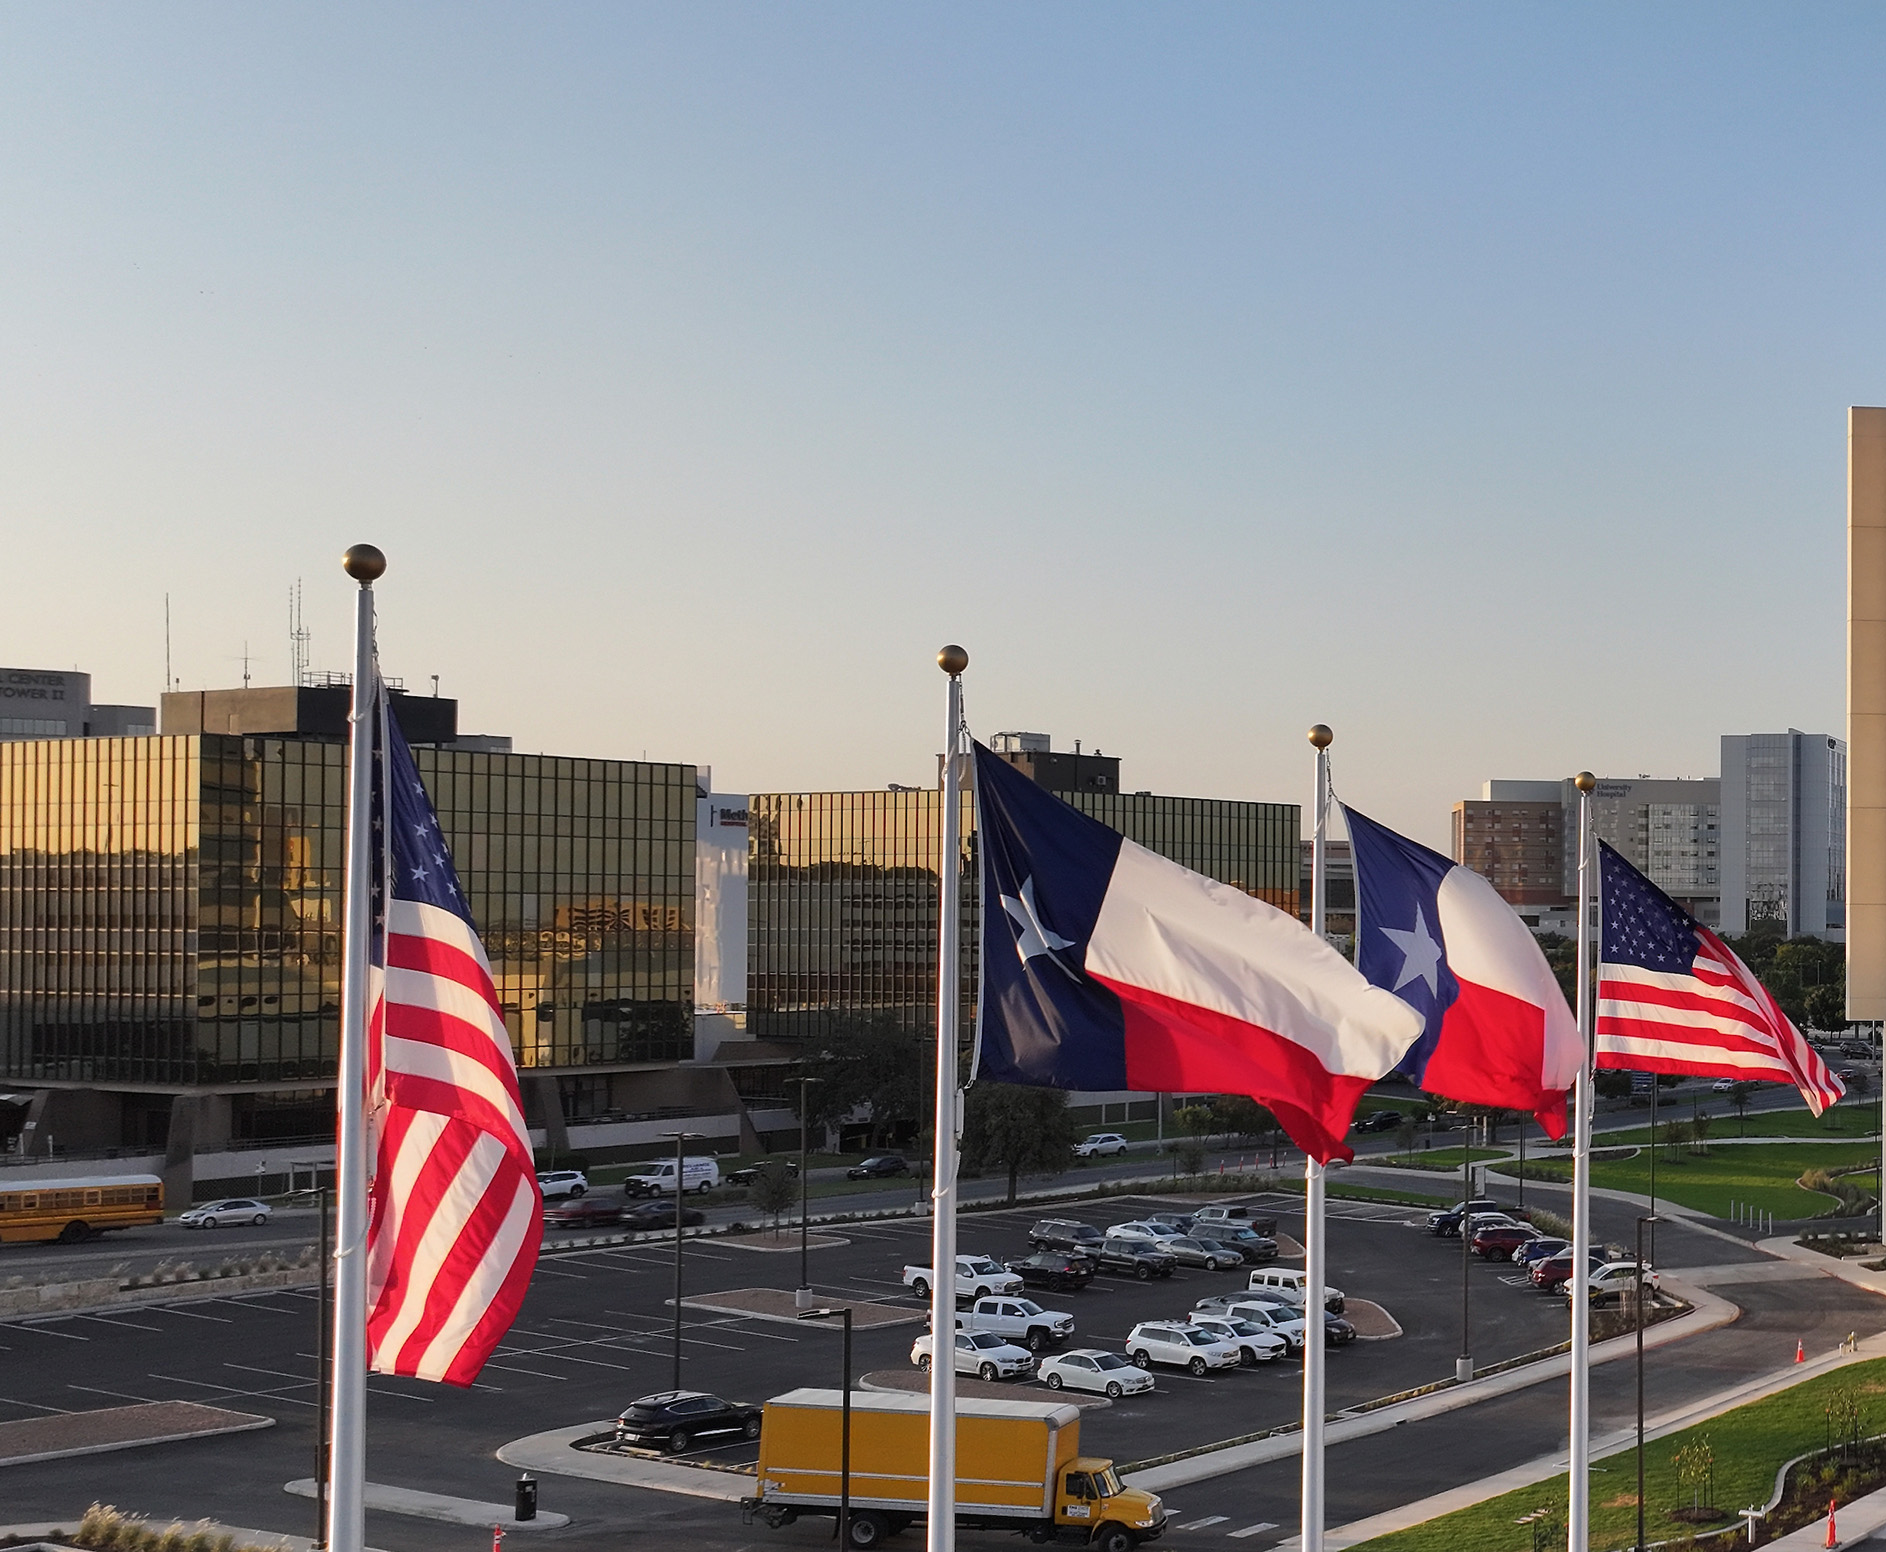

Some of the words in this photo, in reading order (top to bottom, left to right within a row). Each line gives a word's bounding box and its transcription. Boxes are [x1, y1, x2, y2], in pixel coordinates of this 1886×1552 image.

[8, 673, 65, 686] CENTER
[1597, 783, 1632, 792] University
[1597, 790, 1626, 799] Hospital
